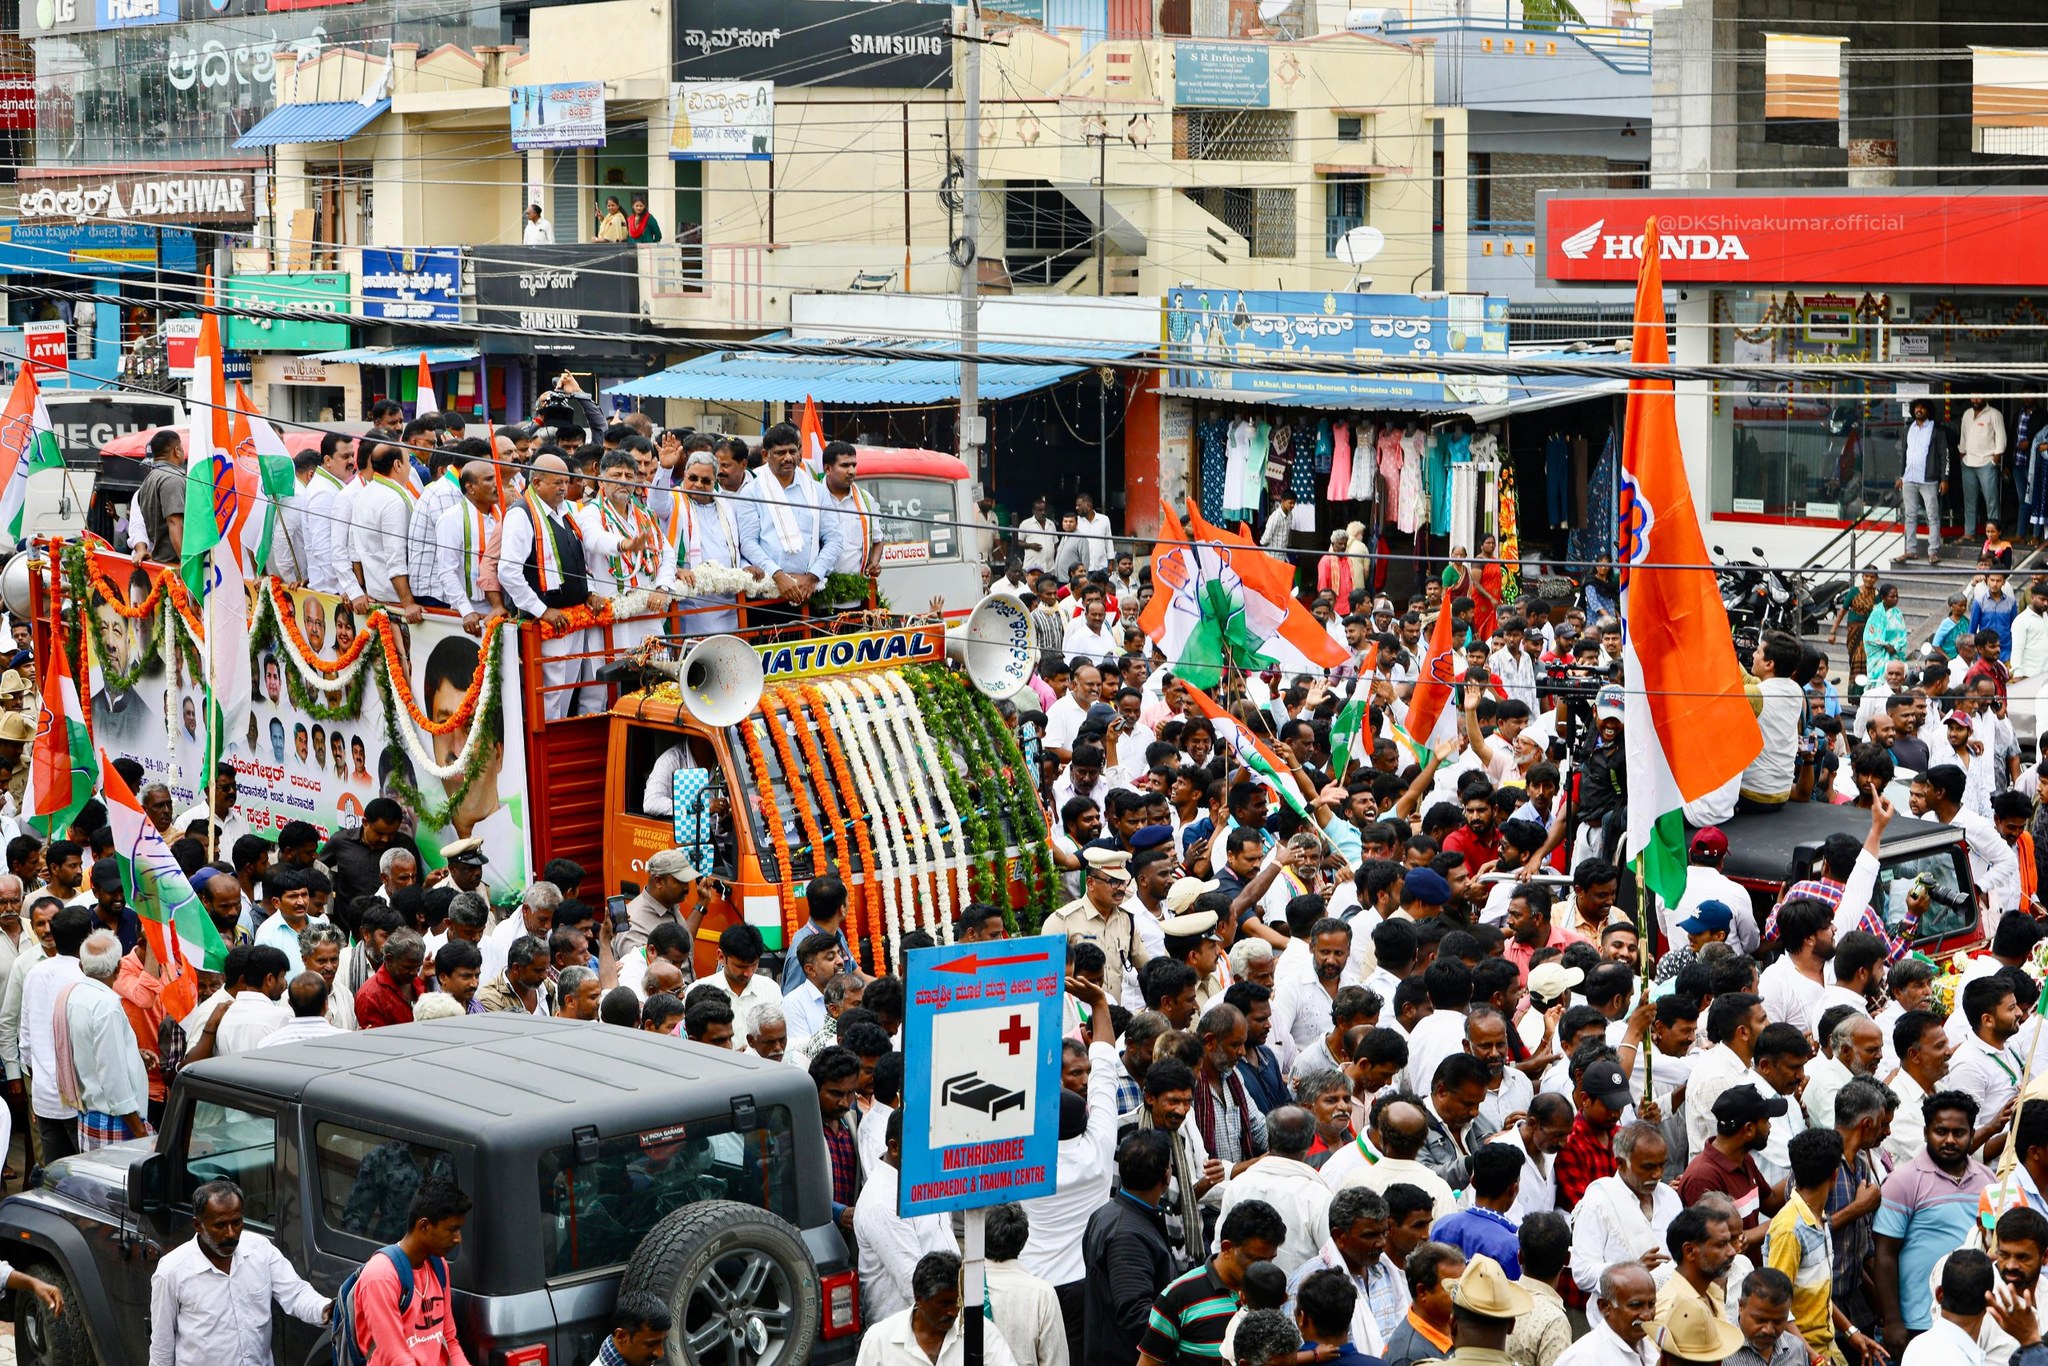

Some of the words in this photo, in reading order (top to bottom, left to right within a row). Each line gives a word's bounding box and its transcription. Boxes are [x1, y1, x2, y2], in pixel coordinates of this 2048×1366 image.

[850, 34, 942, 55] SAMSUNG
[1191, 53, 1198, 61] S
[1201, 53, 1209, 61] R
[1211, 54, 1254, 63] Infotech
[0, 99, 50, 110] amattam
[689, 92, 749, 123] ವಿನ್ಯಾಸ
[130, 178, 246, 216] ADISHWAR
[168, 324, 196, 333] HITACHI
[520, 312, 578, 329] SAMSUNG
[1252, 312, 1354, 345] ಫ್ಯಾಷನ್
[33, 342, 66, 357] ATM
[223, 362, 252, 372] SUNG
[282, 365, 296, 374] WIN
[305, 366, 326, 375] LAKHS
[985, 977, 1007, 1001] ಮತ್ತು
[649, 1131, 663, 1139] INDIA
[943, 1138, 1025, 1171] MATHRUSHREE
[911, 1178, 968, 1203] ORTHOPAEDIC
[970, 1176, 976, 1193] &
[979, 1172, 1012, 1192] TRAUMA
[1014, 1166, 1046, 1186] CENTRE
